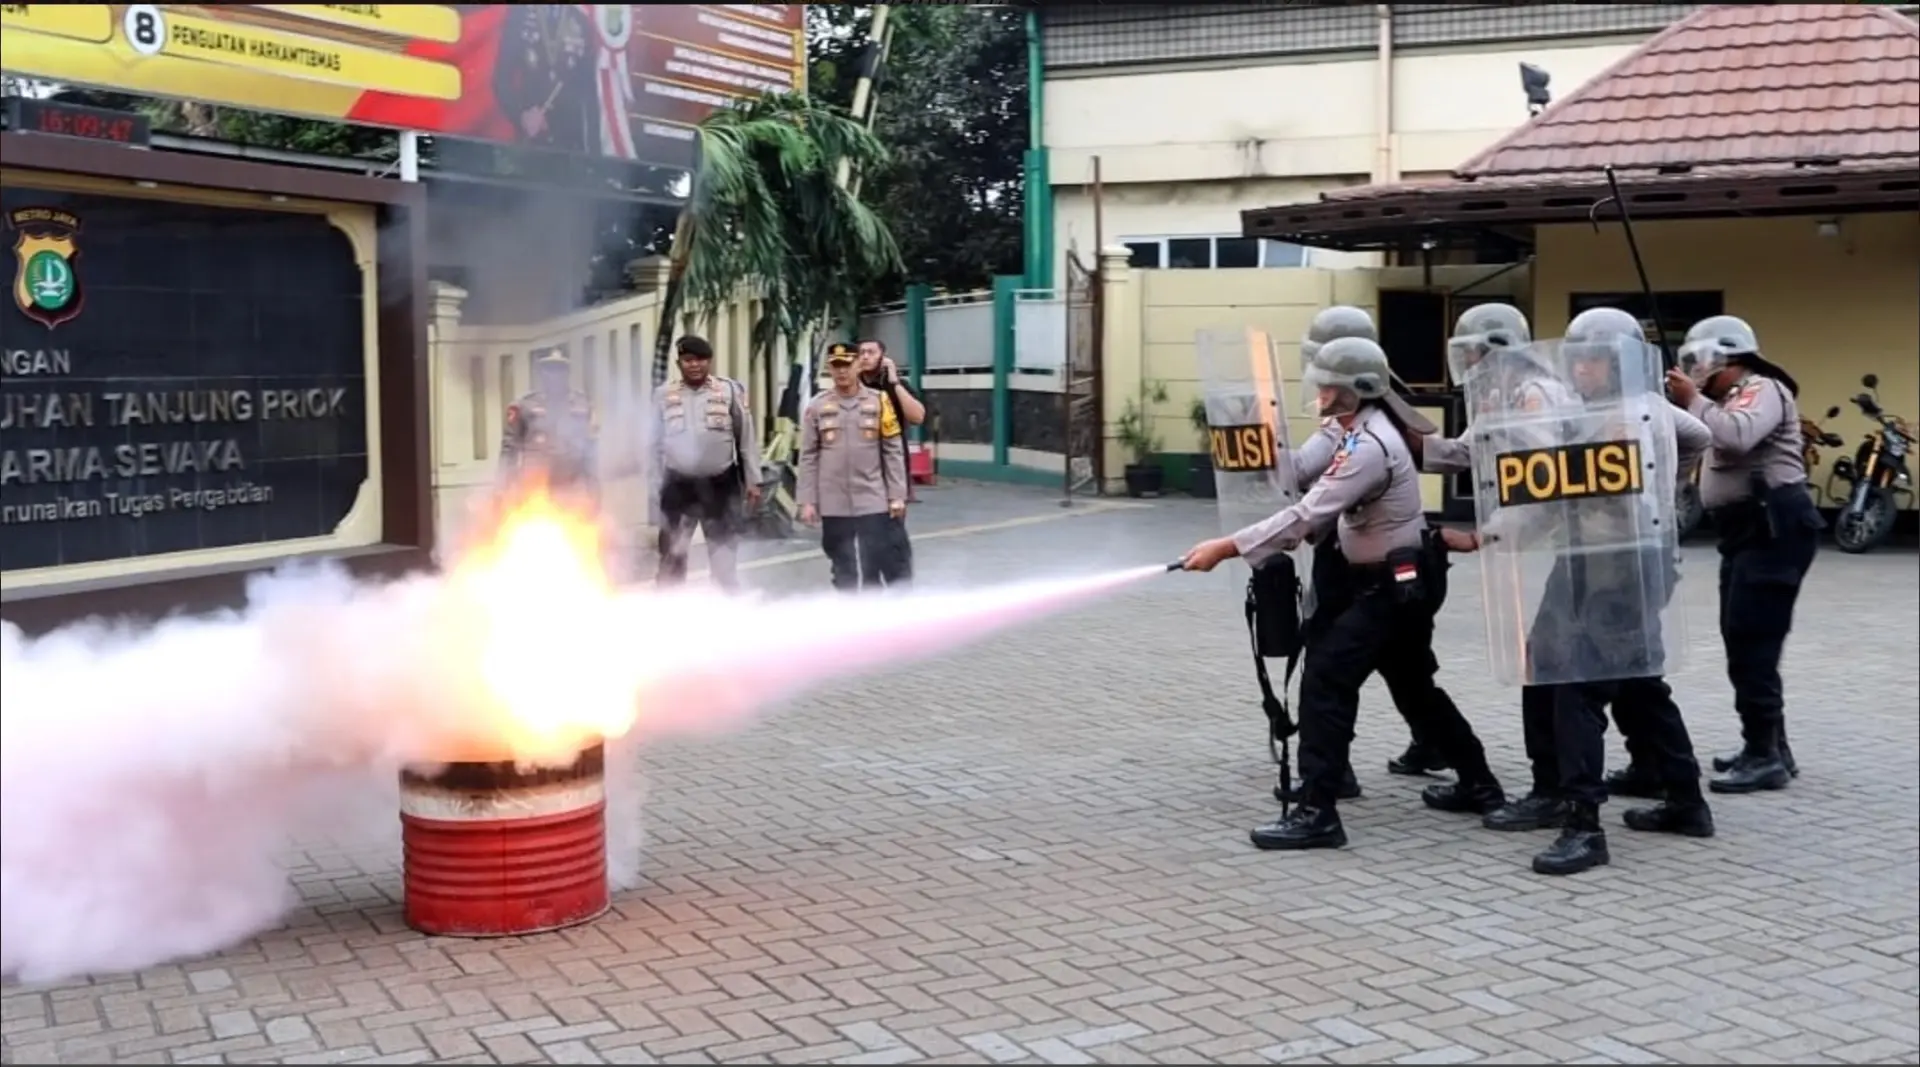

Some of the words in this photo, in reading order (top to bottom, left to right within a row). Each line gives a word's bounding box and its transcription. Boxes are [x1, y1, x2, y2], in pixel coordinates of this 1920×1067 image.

[135, 11, 156, 44] 8
[172, 24, 246, 53] PENGUATAN
[103, 389, 252, 425] TANJUNG
[262, 387, 347, 420] PRIOK
[114, 439, 245, 477] SEVAKA
[1499, 444, 1640, 502] POLISI
[105, 493, 165, 518] Tugas
[170, 484, 273, 511] Pengabdian
